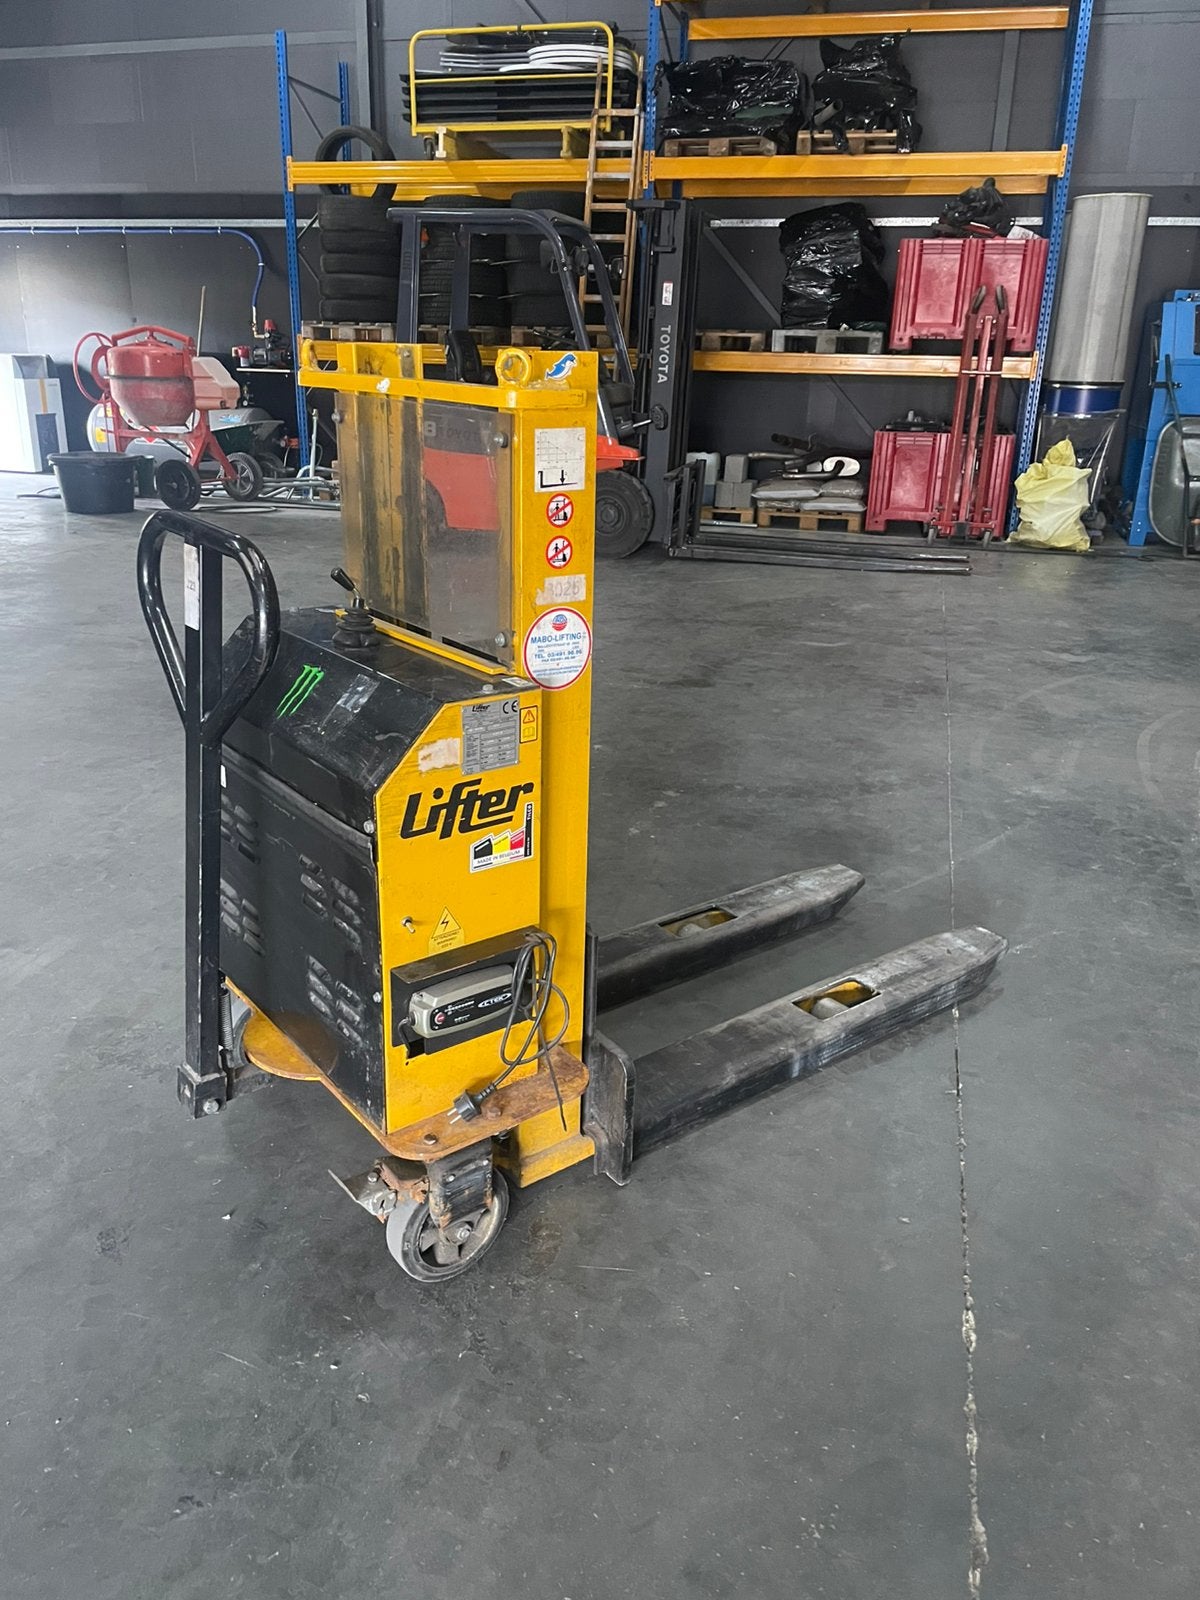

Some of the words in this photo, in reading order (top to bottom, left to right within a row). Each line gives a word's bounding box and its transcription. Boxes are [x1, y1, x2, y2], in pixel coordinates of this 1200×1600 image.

[657, 324, 671, 383] TOYOTA
[530, 632, 582, 644] MABO-LIFTING
[400, 778, 535, 840] Lifter
[476, 857, 492, 865] MADE
[499, 849, 521, 859] BELGIUM
